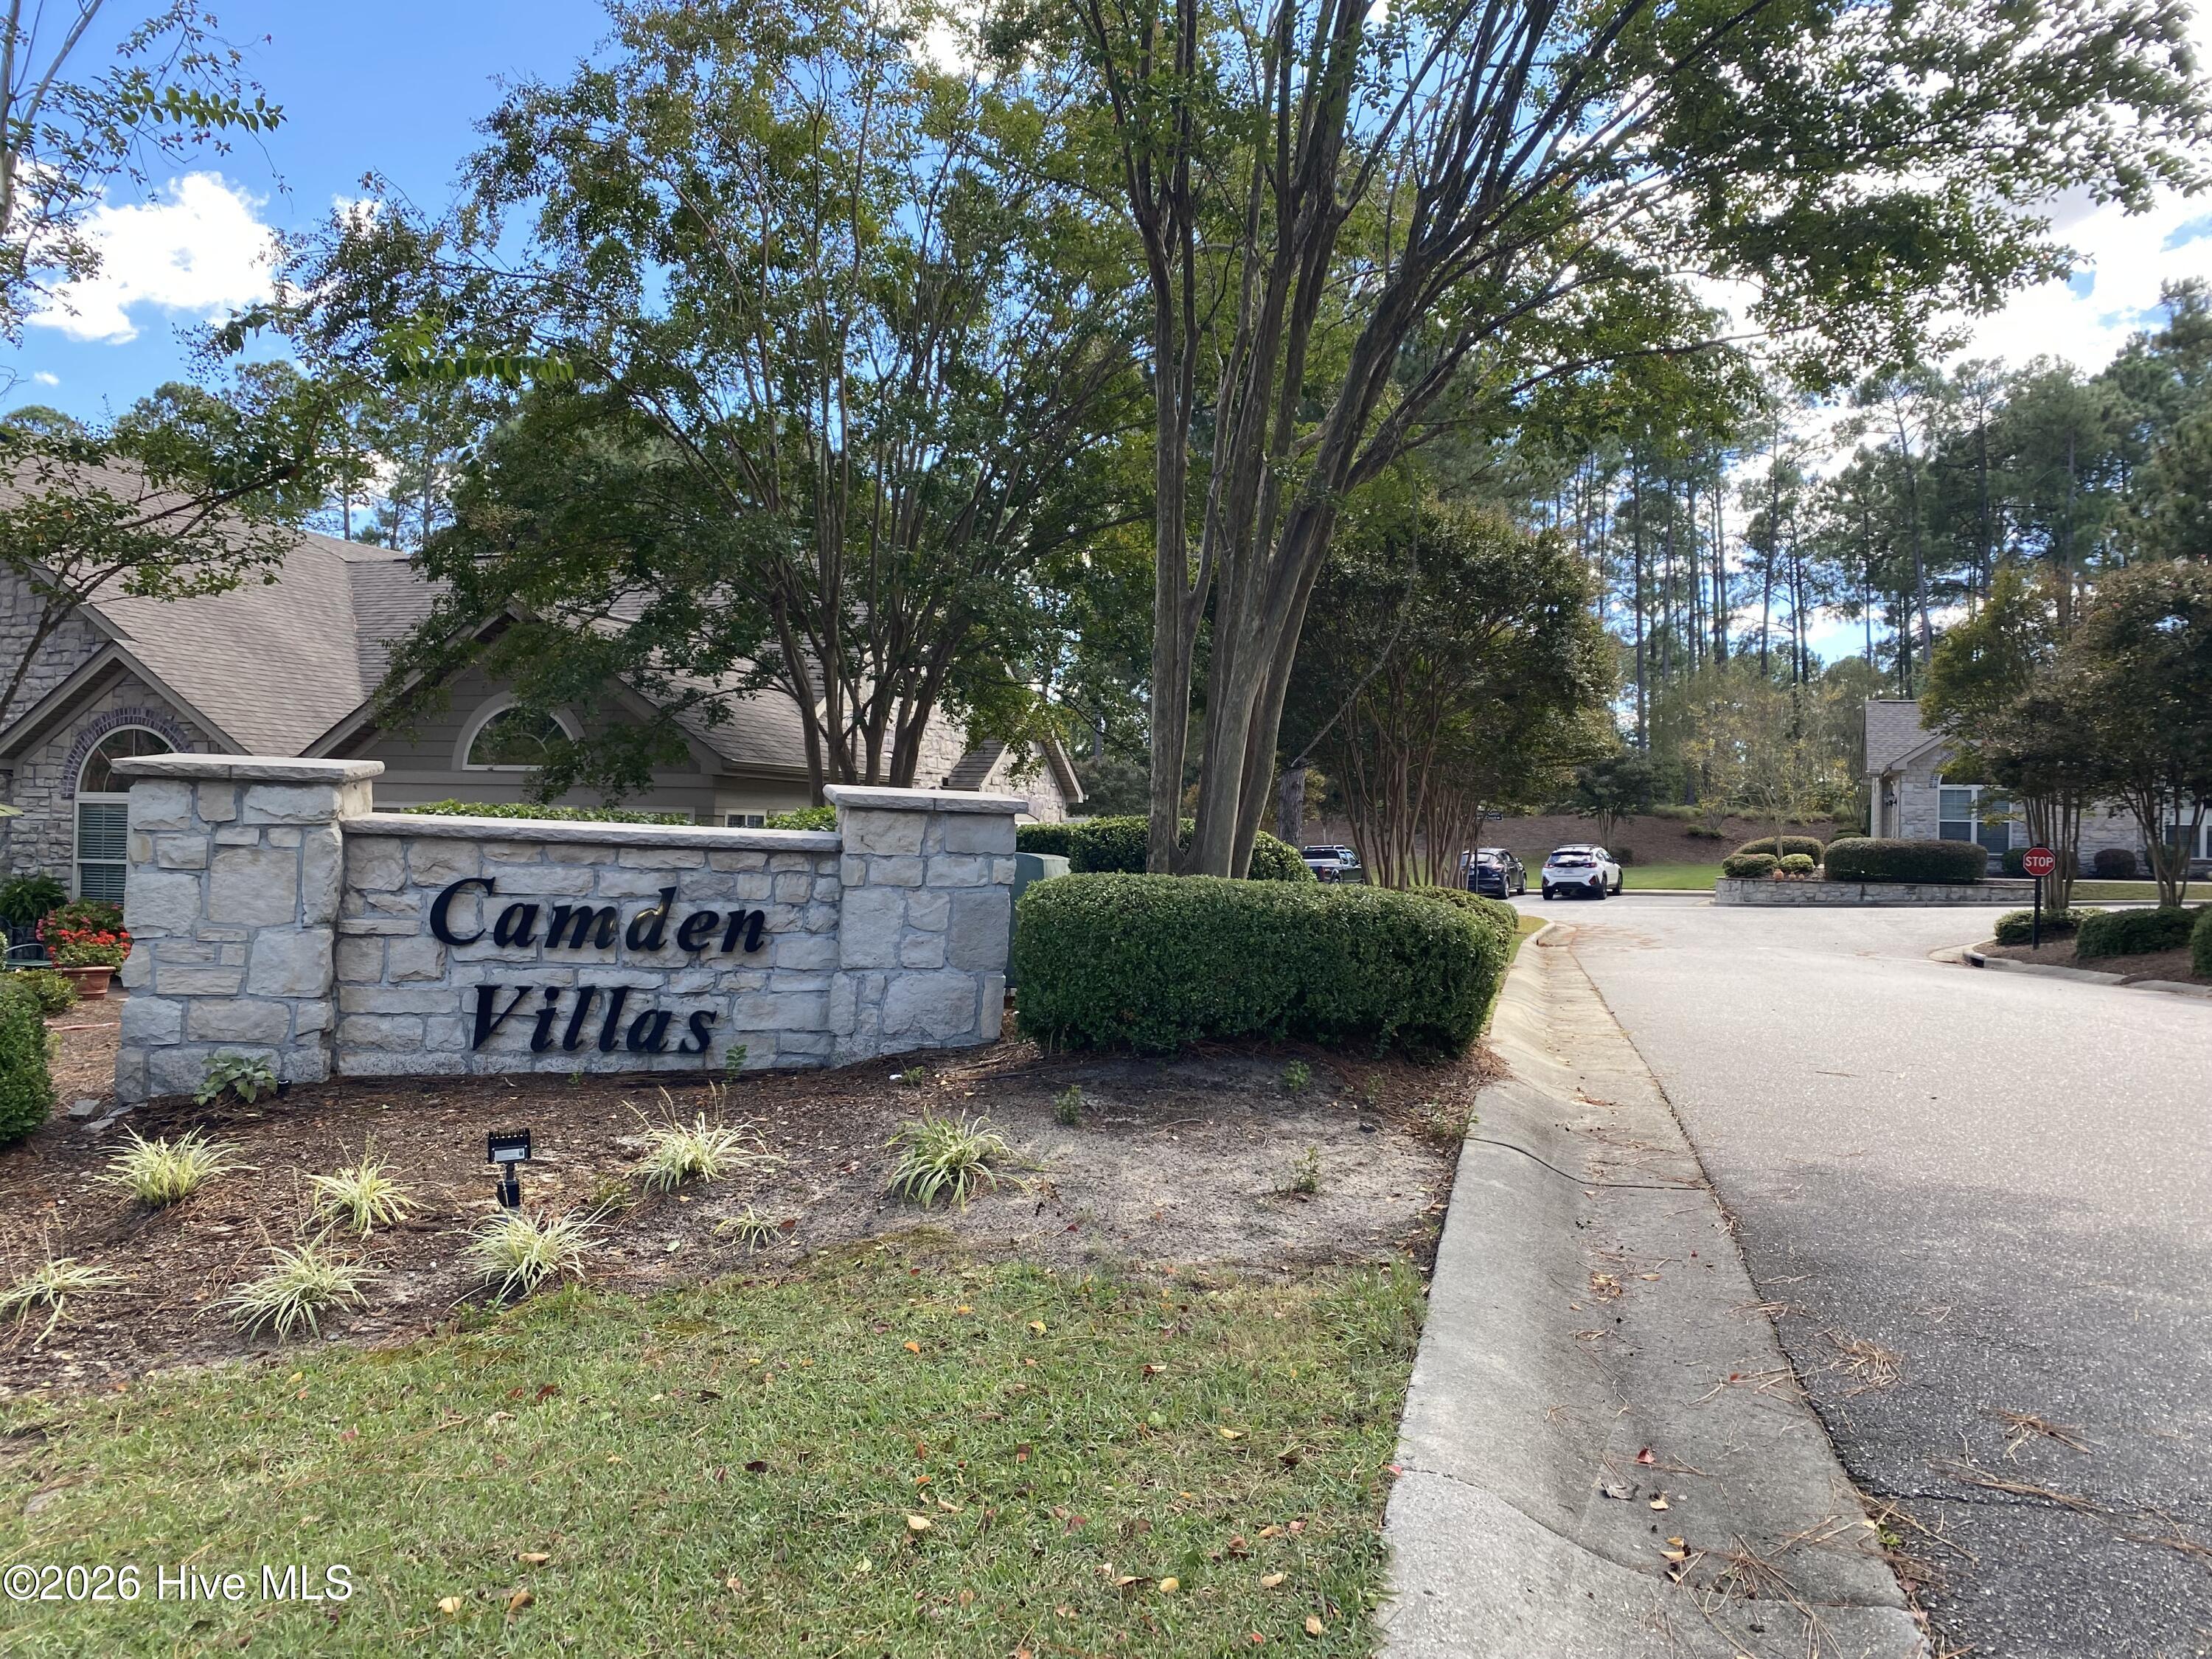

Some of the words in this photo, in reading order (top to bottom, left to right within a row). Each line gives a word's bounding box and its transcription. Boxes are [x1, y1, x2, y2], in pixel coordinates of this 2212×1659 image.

[2025, 856, 2053, 867] STOP
[429, 877, 766, 953] Camden
[472, 984, 717, 1054] Villas
